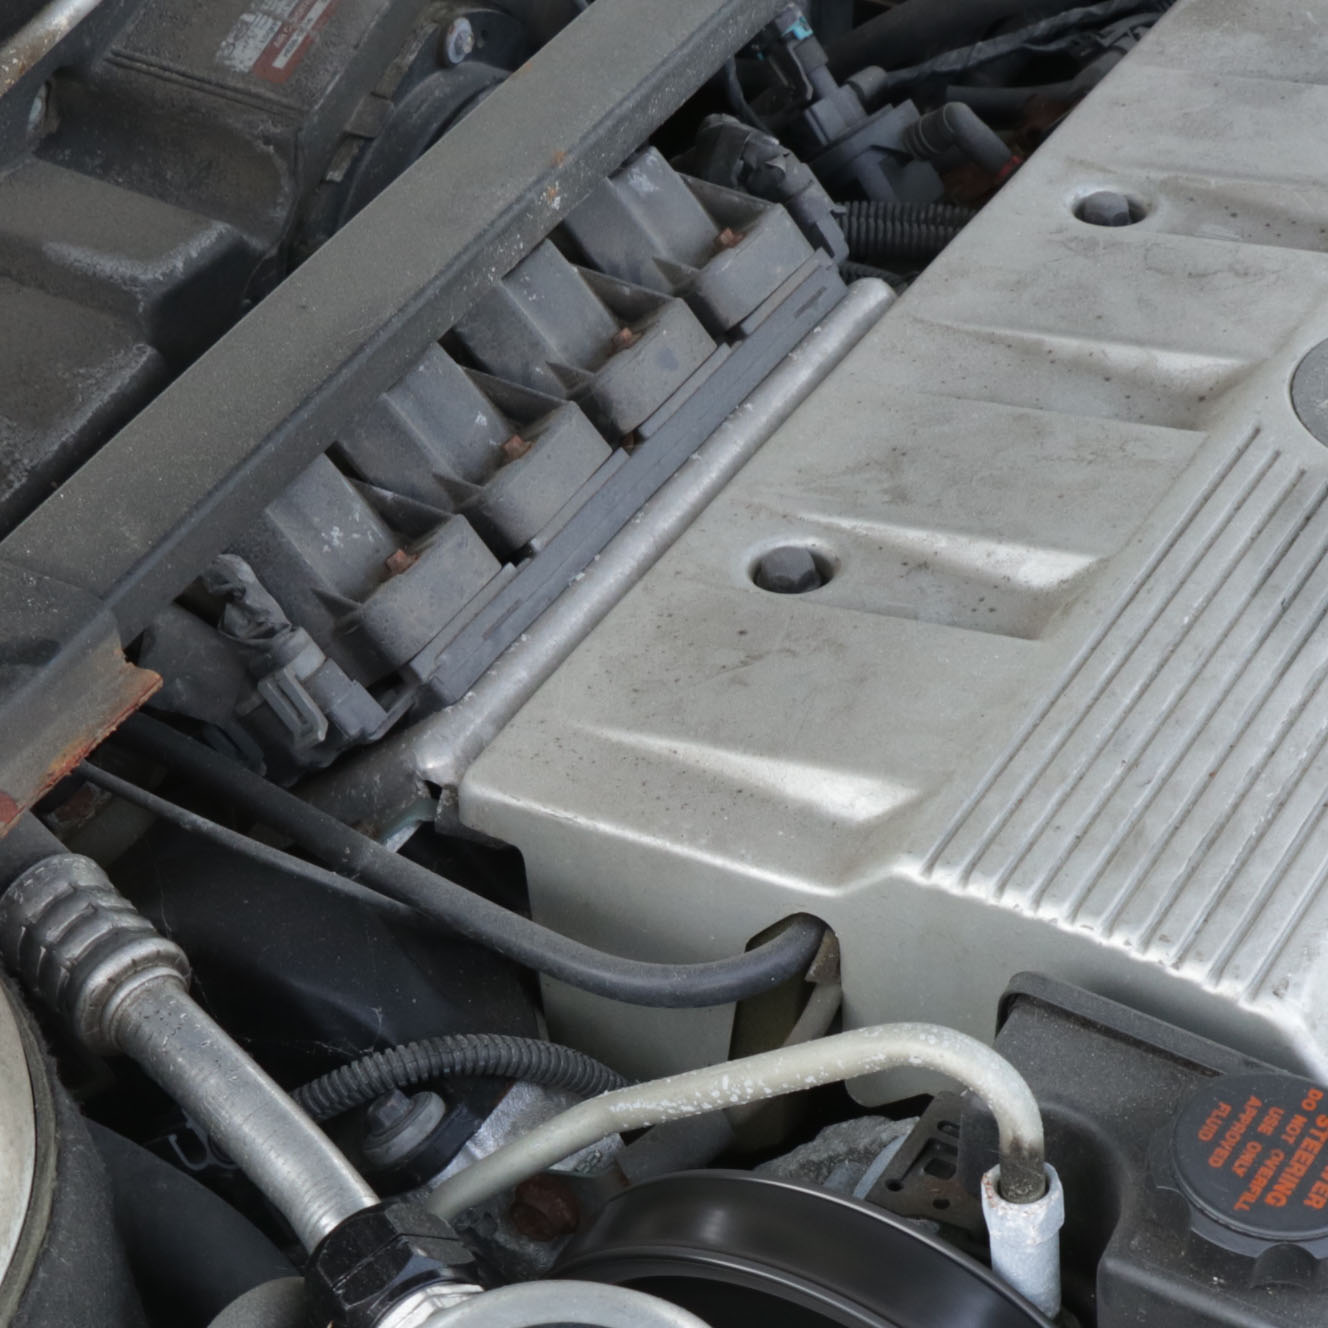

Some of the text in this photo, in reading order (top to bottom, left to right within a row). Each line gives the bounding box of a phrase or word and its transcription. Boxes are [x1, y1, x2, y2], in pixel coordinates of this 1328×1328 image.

[1197, 1102, 1230, 1141] FLUID
[1207, 1097, 1262, 1167] APPROVED
[1231, 1107, 1283, 1175] USE ONLY
[1234, 1089, 1322, 1212] DO NOT OVERFILL
